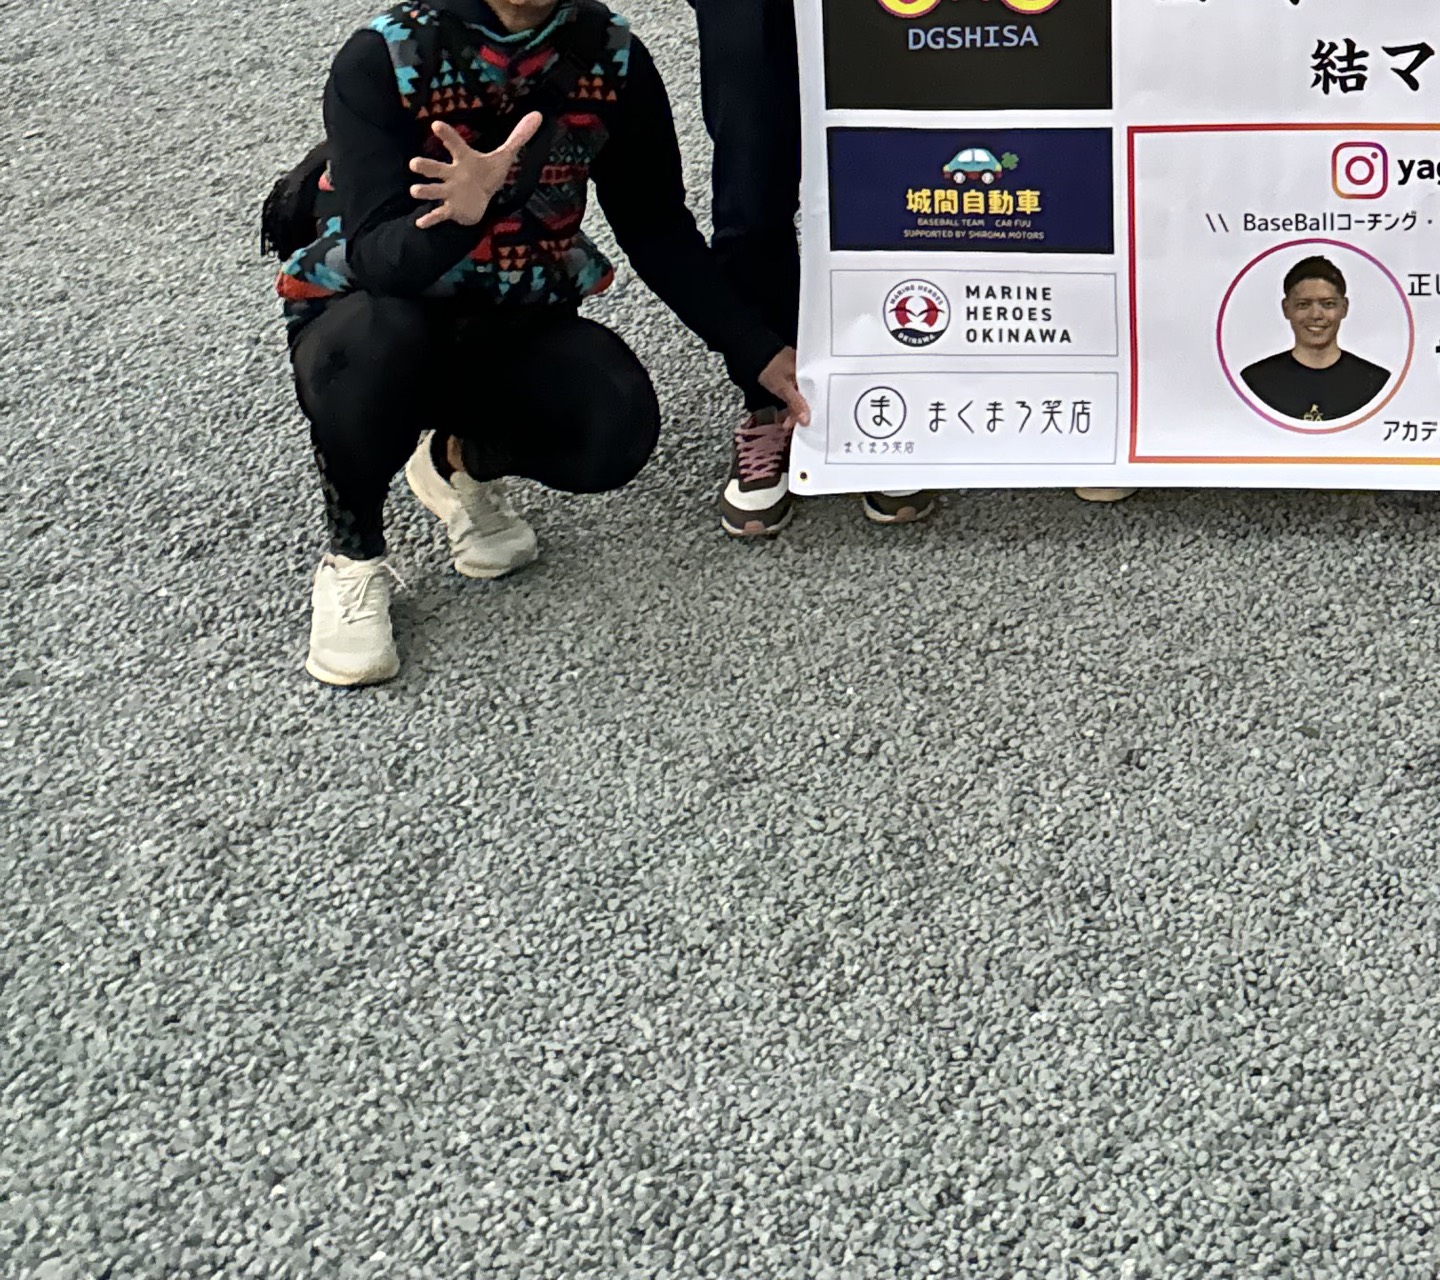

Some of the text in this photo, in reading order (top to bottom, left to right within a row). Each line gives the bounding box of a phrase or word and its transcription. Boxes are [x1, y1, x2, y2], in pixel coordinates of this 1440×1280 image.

[907, 25, 1039, 51] DGSHISA
[905, 188, 1042, 215] 城間自動車
[917, 217, 959, 227] BASEBALL
[961, 218, 985, 228] TEAM
[903, 228, 953, 238] SUPPORTED
[954, 229, 967, 238] BY
[1008, 230, 1045, 240] MOTORS
[965, 285, 1052, 301] MARINE
[965, 306, 1053, 322] HEROES
[965, 328, 1073, 344] OKINAWA
